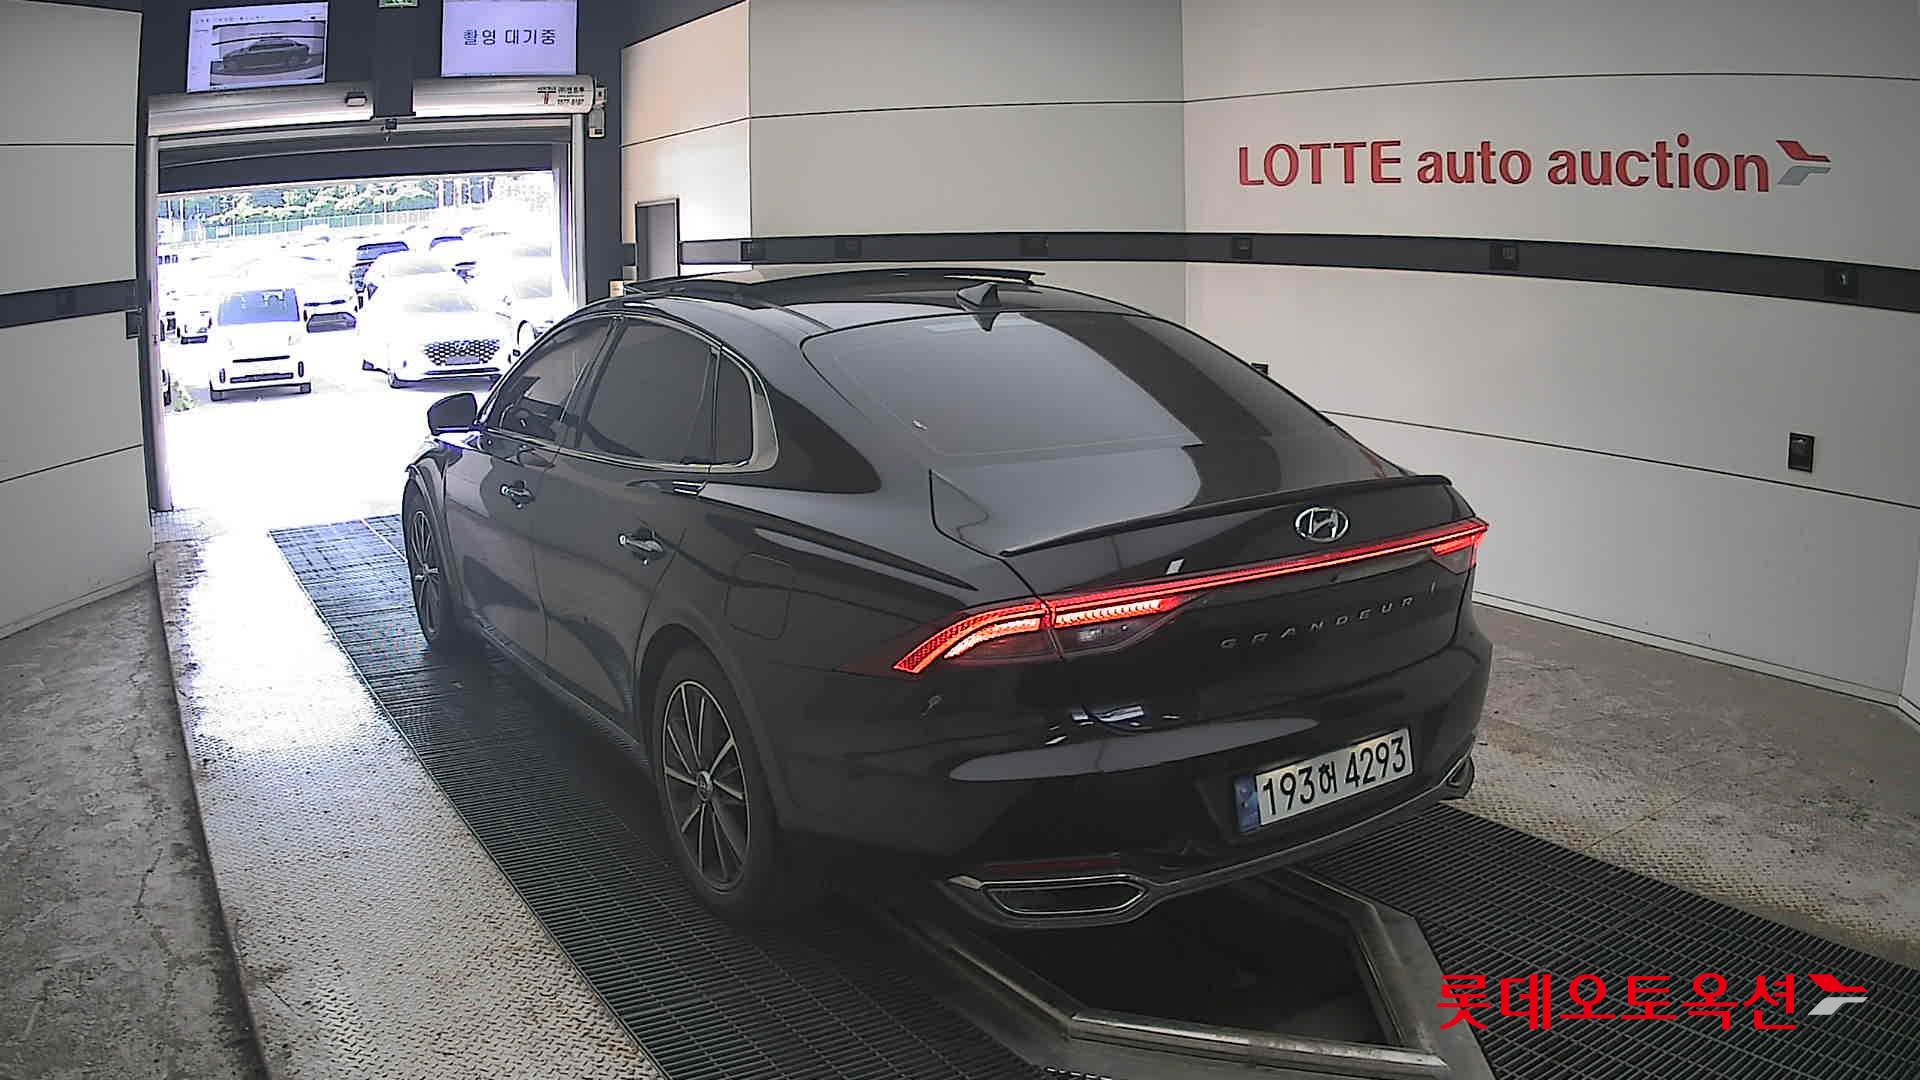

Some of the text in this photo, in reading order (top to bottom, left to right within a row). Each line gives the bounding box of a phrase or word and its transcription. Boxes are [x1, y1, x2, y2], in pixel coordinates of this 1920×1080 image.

[504, 28, 557, 46] 대기중
[1238, 133, 1769, 192] LOTTE auto auction
[1219, 596, 1414, 649] GRANDEUR
[1262, 737, 1407, 816] 193허 4293
